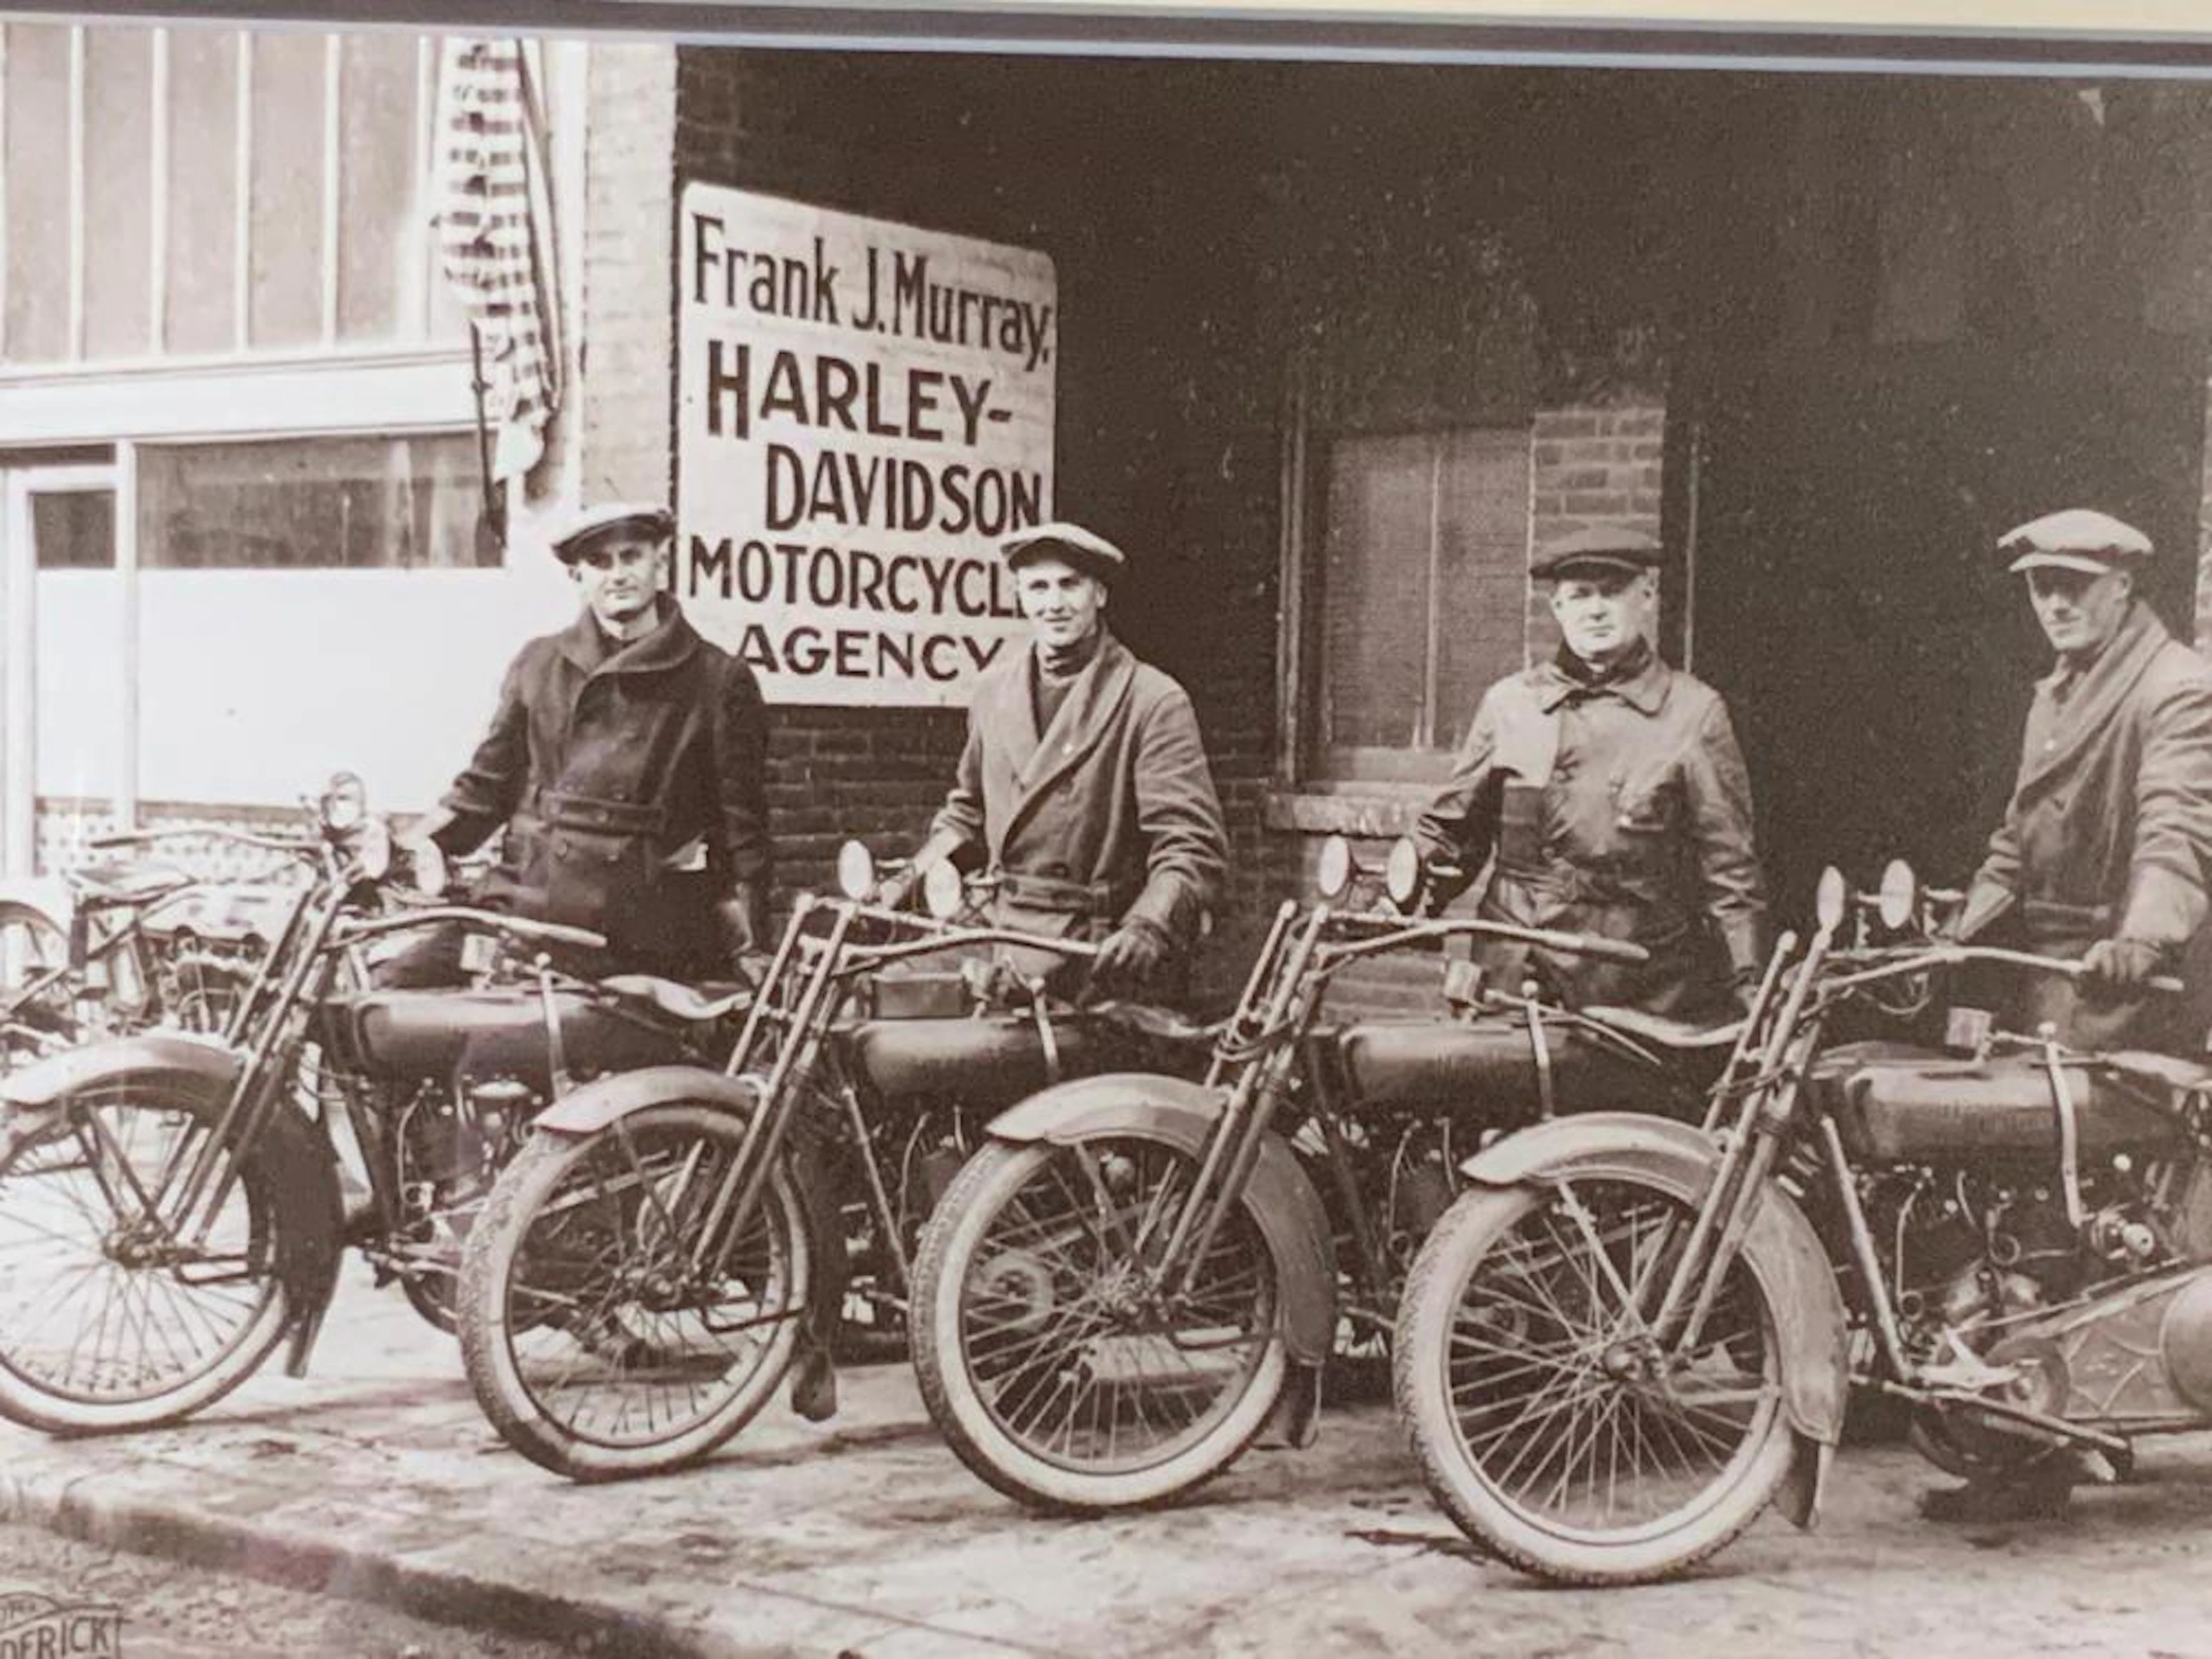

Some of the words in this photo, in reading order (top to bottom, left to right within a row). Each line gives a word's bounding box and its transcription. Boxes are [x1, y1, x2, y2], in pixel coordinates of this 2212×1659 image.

[692, 212, 840, 324] Frank
[851, 246, 885, 334] J.
[708, 340, 1012, 445] HARLEY-
[765, 443, 1041, 537] DAVIDSON
[689, 535, 1029, 619] MOTORCYCL
[737, 624, 1005, 681] AGENCY
